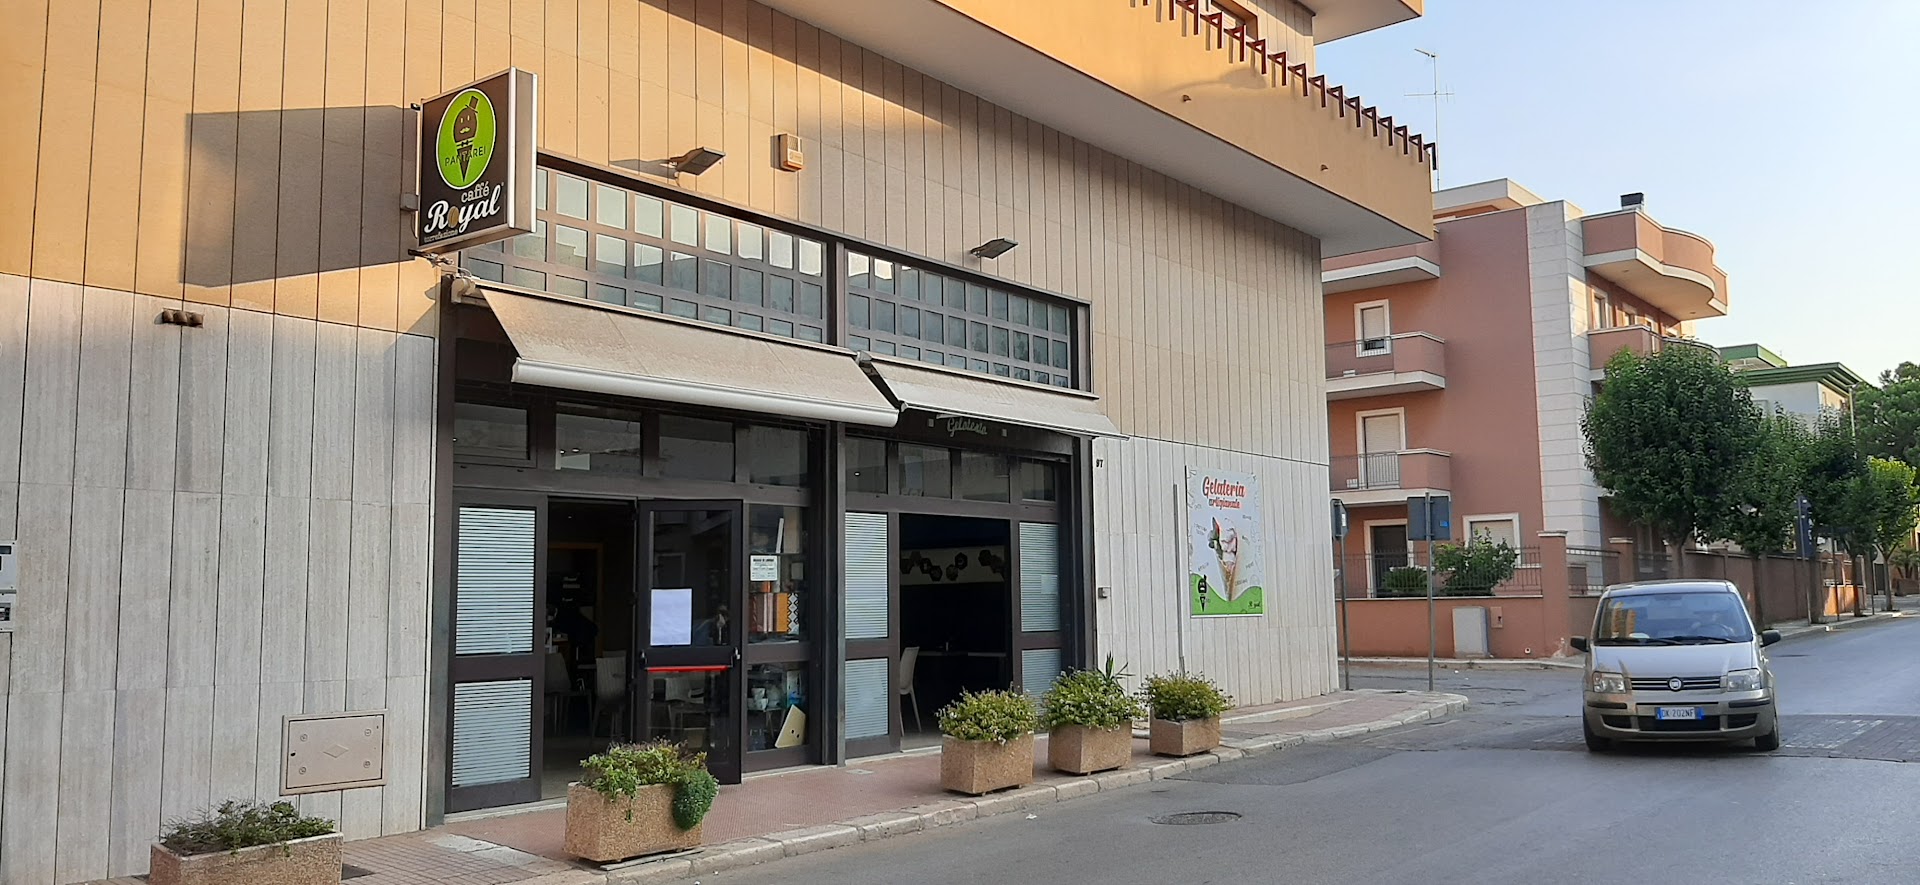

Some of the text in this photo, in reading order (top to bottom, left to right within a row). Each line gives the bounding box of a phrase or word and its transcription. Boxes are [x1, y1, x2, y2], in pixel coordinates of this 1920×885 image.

[444, 145, 486, 167] PANTAREI
[423, 184, 501, 234] Royal
[1202, 475, 1246, 499] Gelateria
[1208, 497, 1241, 510] artigianale
